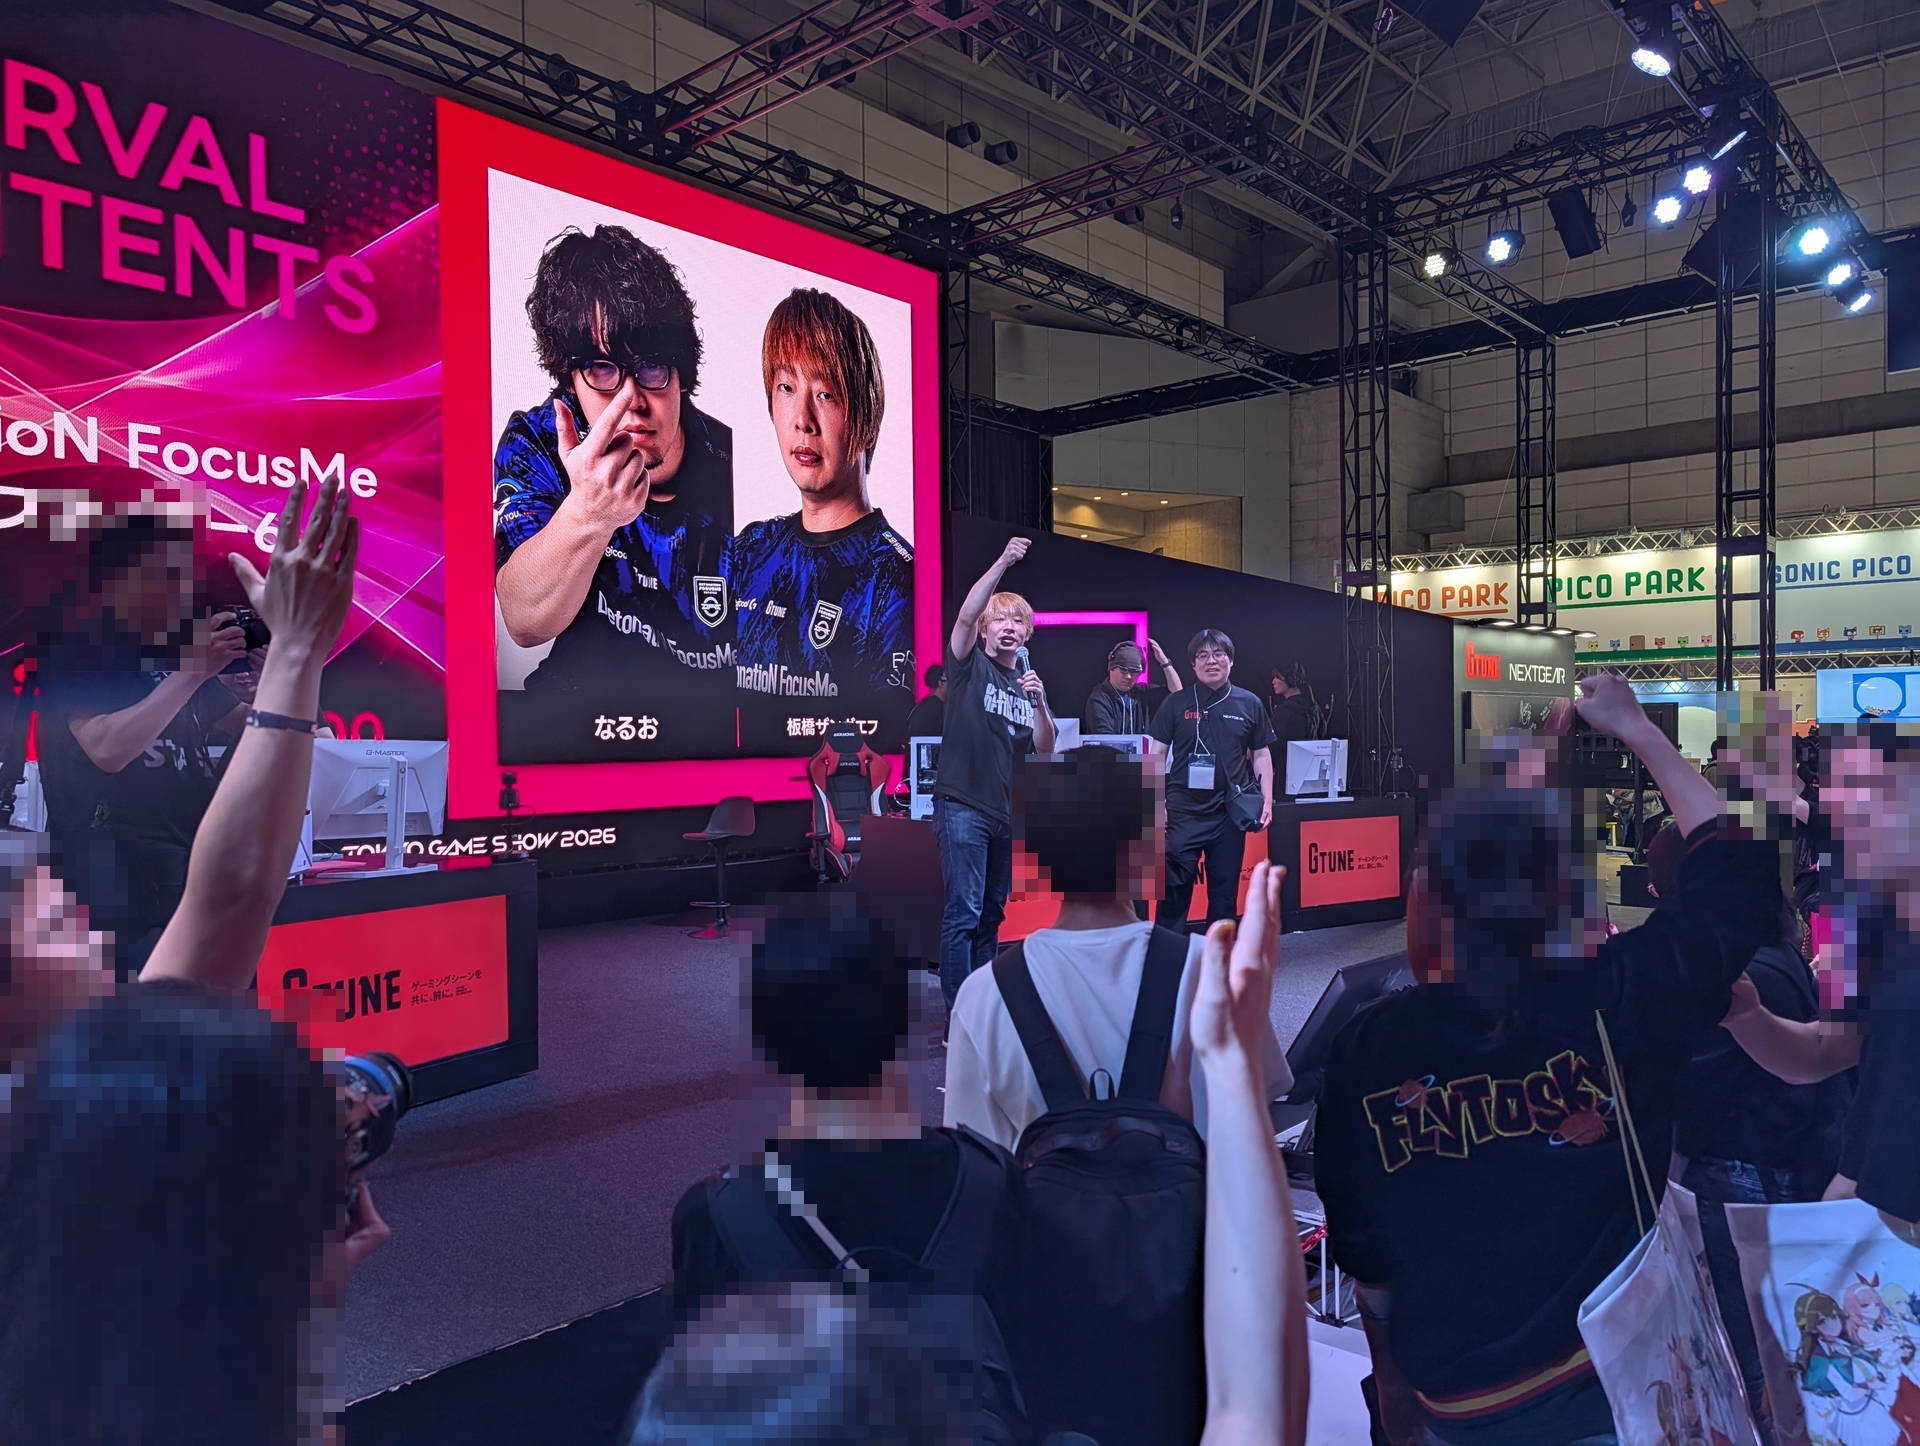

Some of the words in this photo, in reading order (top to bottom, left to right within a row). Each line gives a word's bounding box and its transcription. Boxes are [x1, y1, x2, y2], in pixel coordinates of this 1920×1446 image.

[127, 421, 378, 498] FocusMe
[1852, 554, 1912, 578] PICO
[1441, 581, 1509, 609] PARK
[1625, 566, 1705, 597] PARK
[1466, 641, 1501, 680] GTUNE
[1509, 662, 1566, 685] NEXTGEAR
[594, 714, 659, 741] なるお
[560, 826, 617, 848] 2026
[1308, 842, 1355, 875] GTUNE
[411, 969, 483, 993] ゲーミングシーンを
